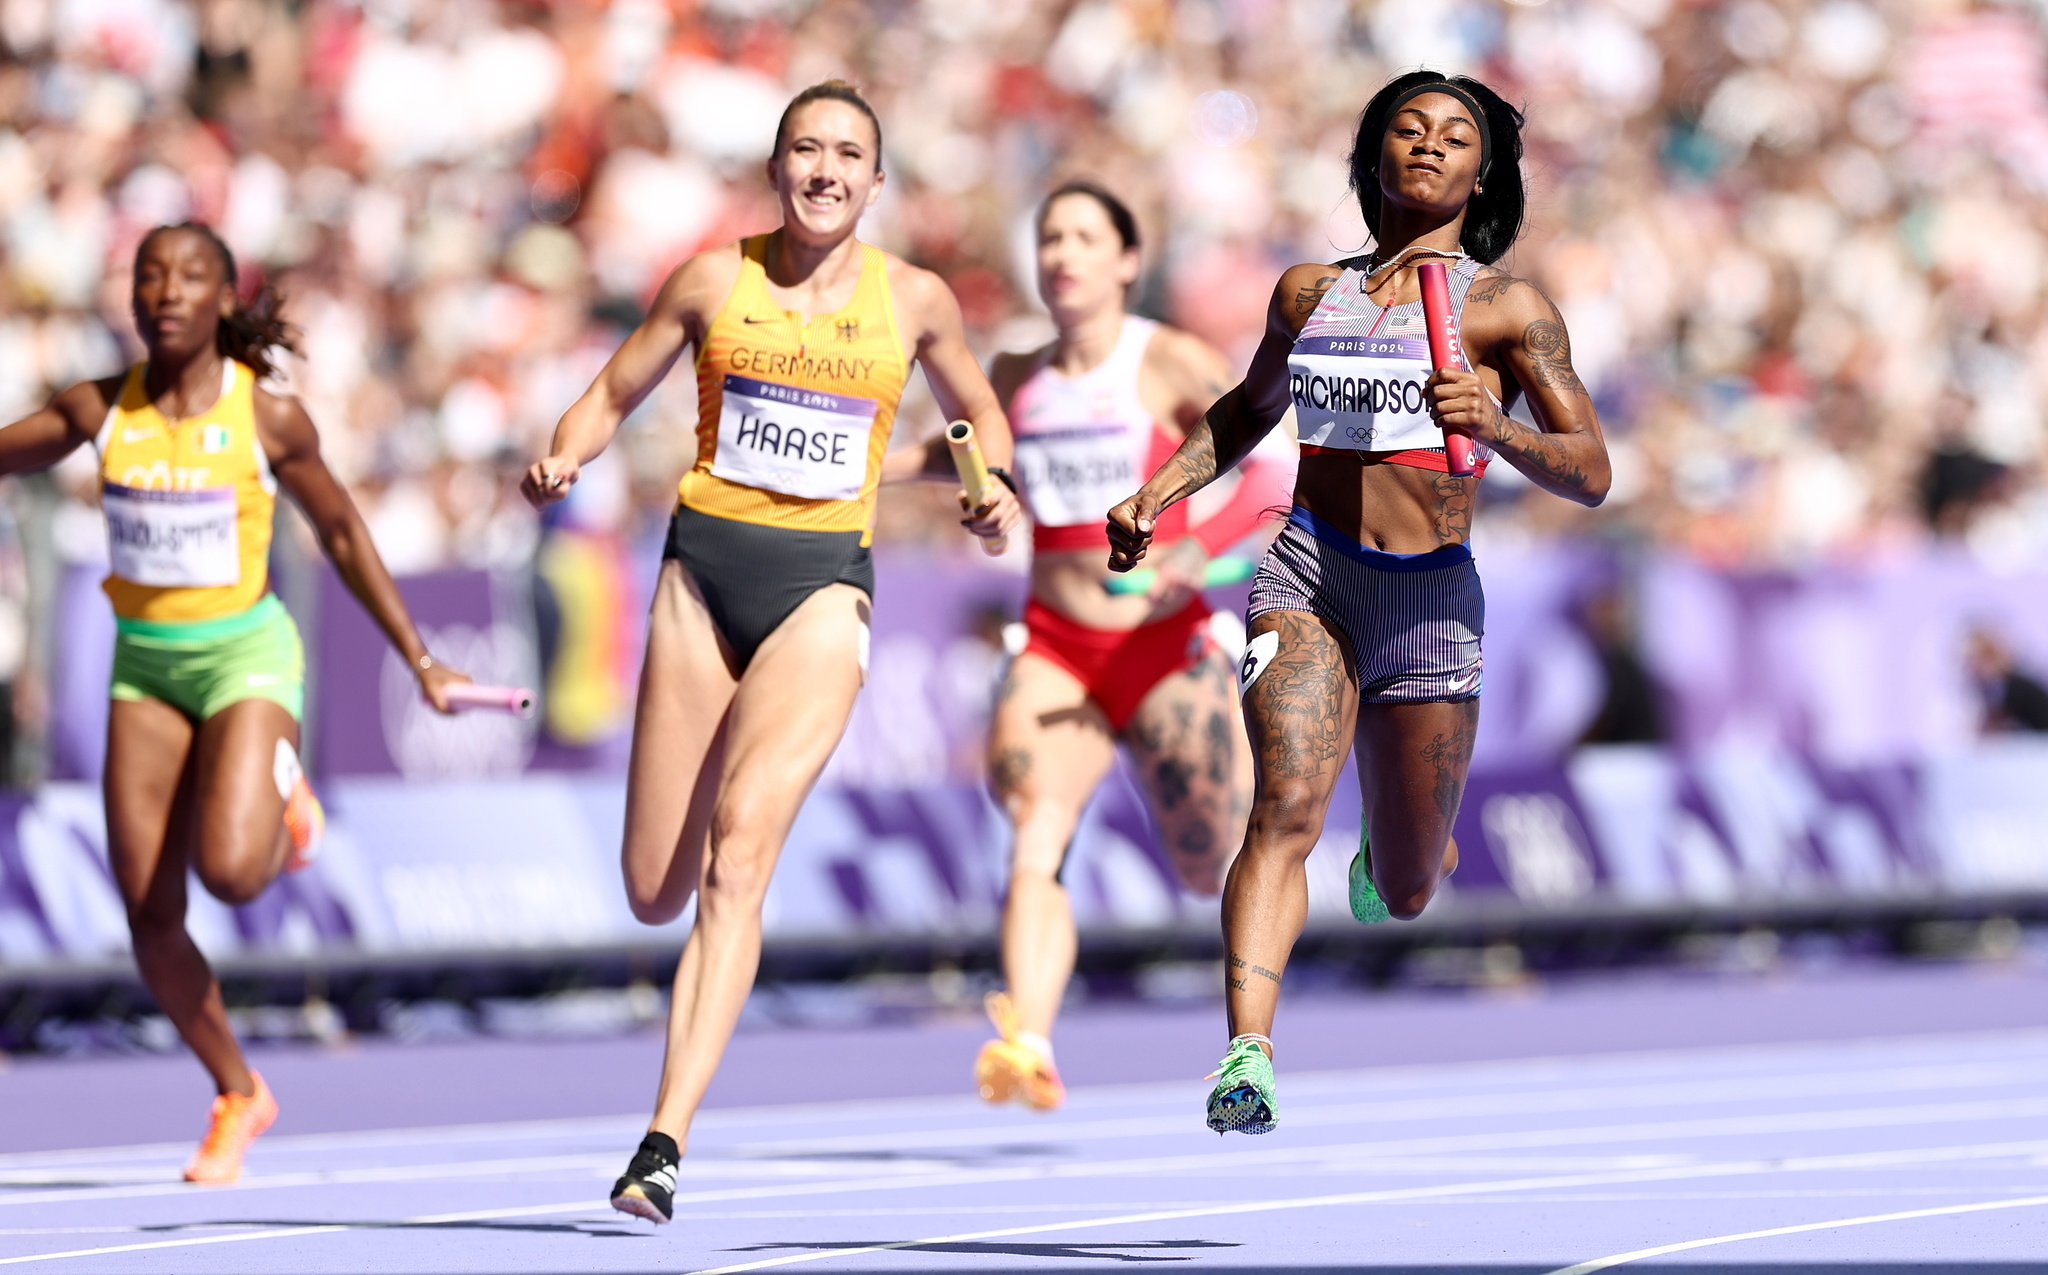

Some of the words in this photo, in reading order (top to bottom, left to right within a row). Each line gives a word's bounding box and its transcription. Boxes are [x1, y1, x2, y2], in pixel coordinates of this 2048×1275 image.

[1329, 341, 1366, 352] PARIS
[1370, 343, 1404, 353] 2024
[1445, 315, 1460, 363] 2024
[730, 347, 875, 380] GERMANY
[759, 384, 800, 403] PARIS
[802, 392, 839, 409] 2024
[1292, 373, 1430, 415] RICHARDSO
[737, 413, 848, 465] HAASE
[1467, 451, 1475, 466] 6
[1241, 649, 1258, 684] 6
